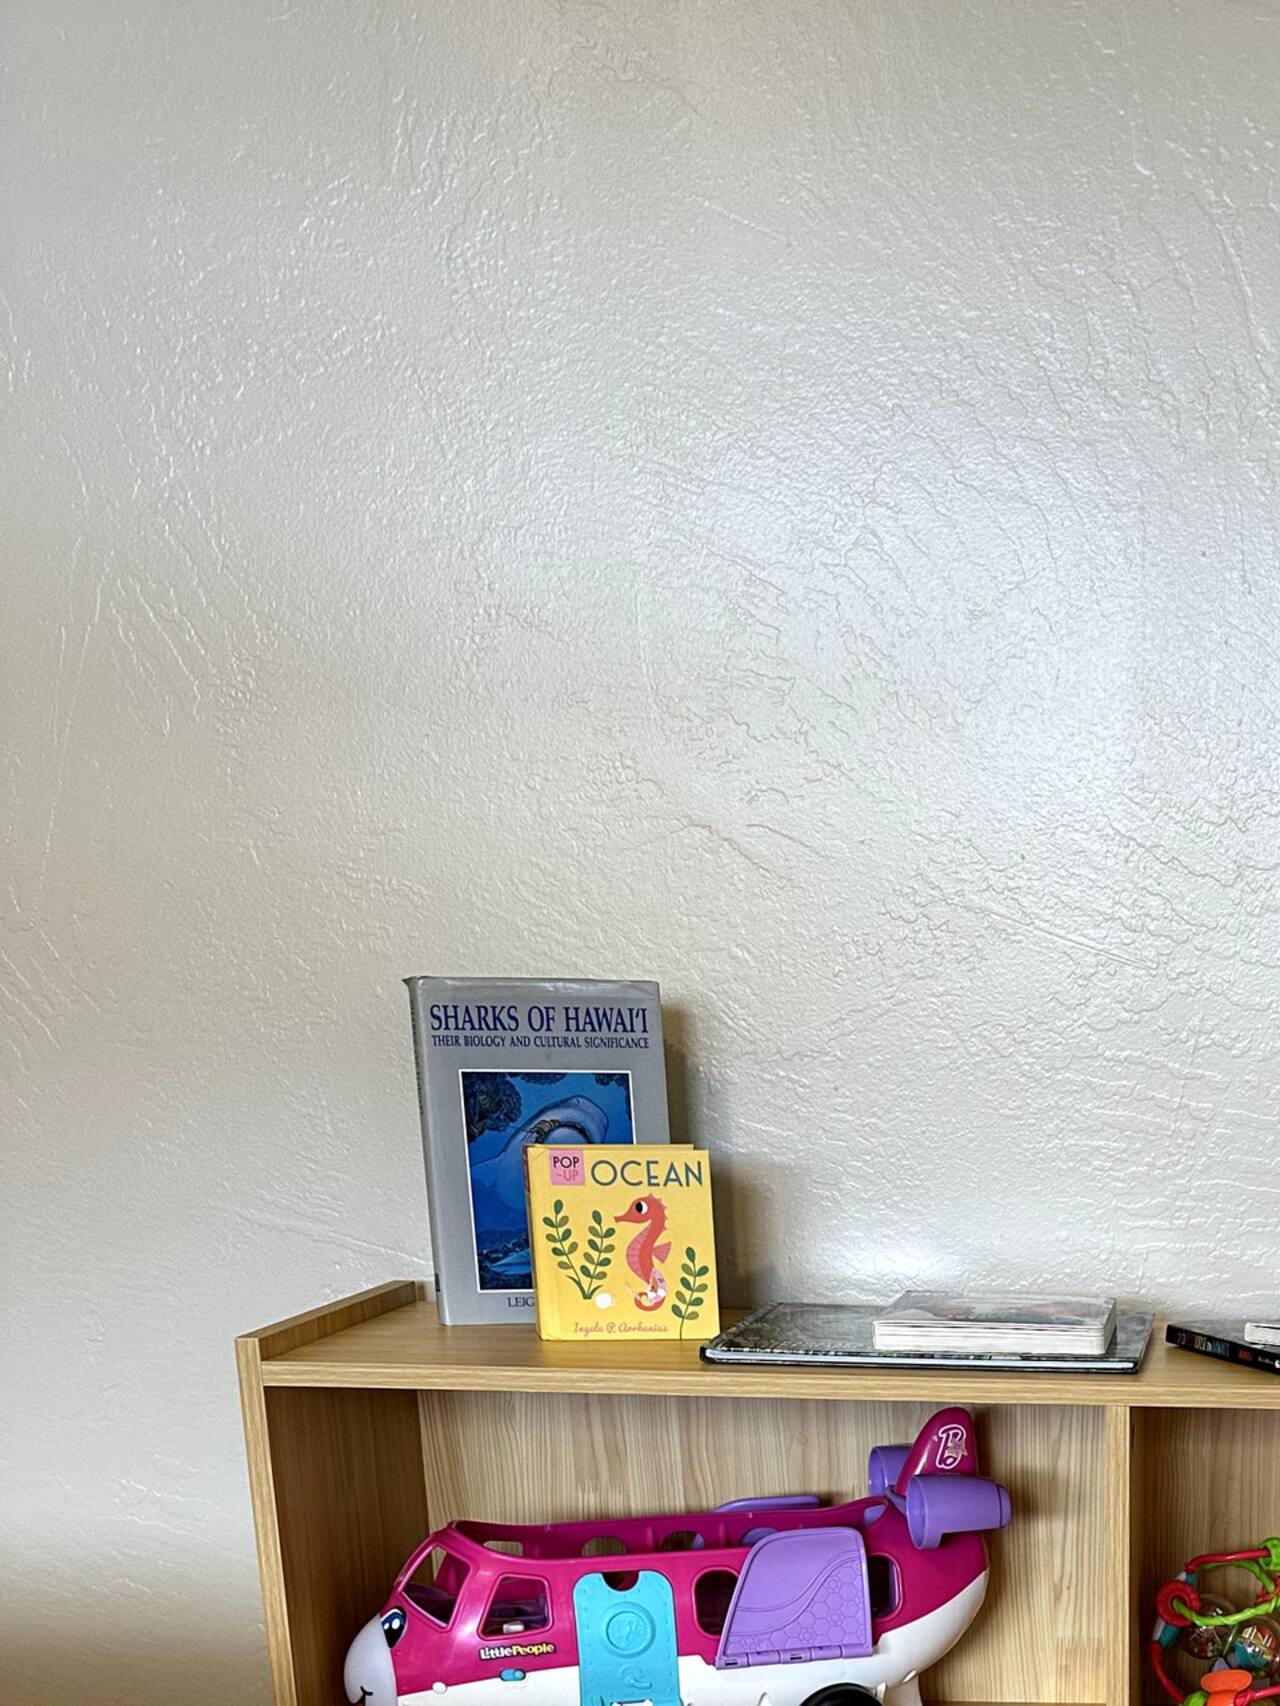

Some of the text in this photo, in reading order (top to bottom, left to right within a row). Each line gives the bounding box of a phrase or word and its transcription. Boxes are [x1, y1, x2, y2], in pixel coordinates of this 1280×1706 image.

[430, 1004, 519, 1032] SHARKS
[527, 1005, 556, 1032] OF
[431, 1034, 649, 1049] THEIR BIOLOGY AND CULTURAL SIGNIFICANCE
[552, 1156, 703, 1187] POP OCEAN
